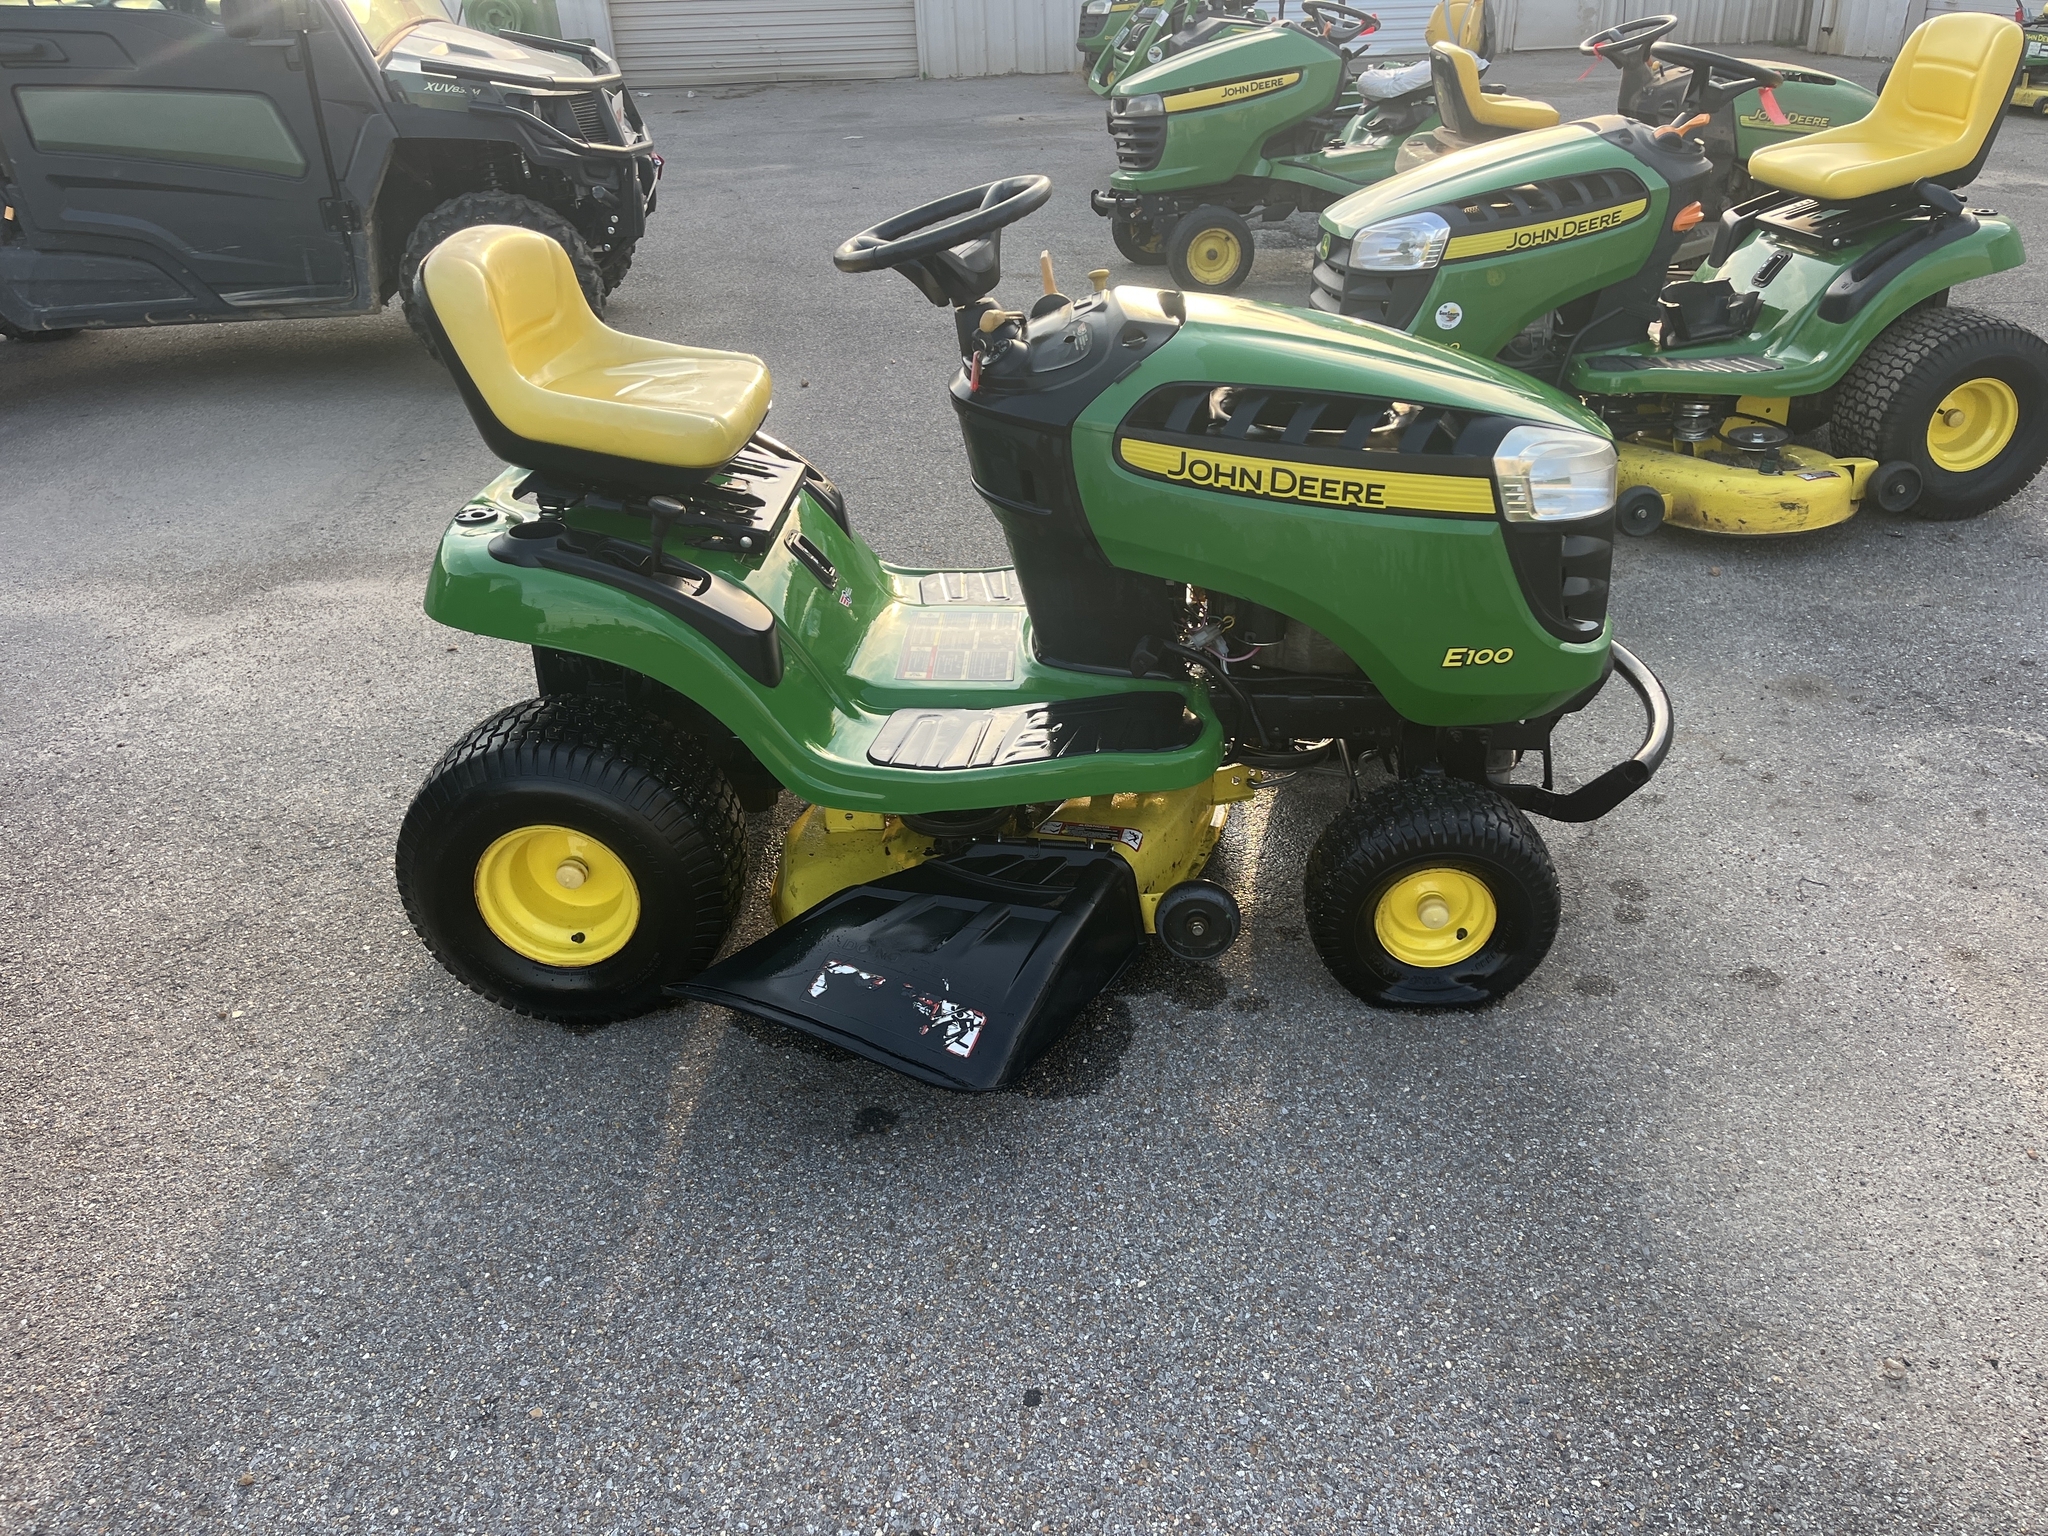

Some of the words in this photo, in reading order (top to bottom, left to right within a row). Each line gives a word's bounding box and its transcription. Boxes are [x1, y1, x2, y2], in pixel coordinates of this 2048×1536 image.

[1221, 85, 1249, 98] JOHN
[1250, 78, 1284, 92] DEERE
[1749, 109, 1787, 122] JO
[1787, 112, 1830, 127] DEERE
[1506, 227, 1559, 249] JOHN
[1562, 210, 1622, 238] DEERE
[1167, 451, 1262, 491] JOHN
[1270, 467, 1386, 505] DEERE
[1441, 647, 1515, 668] E100
